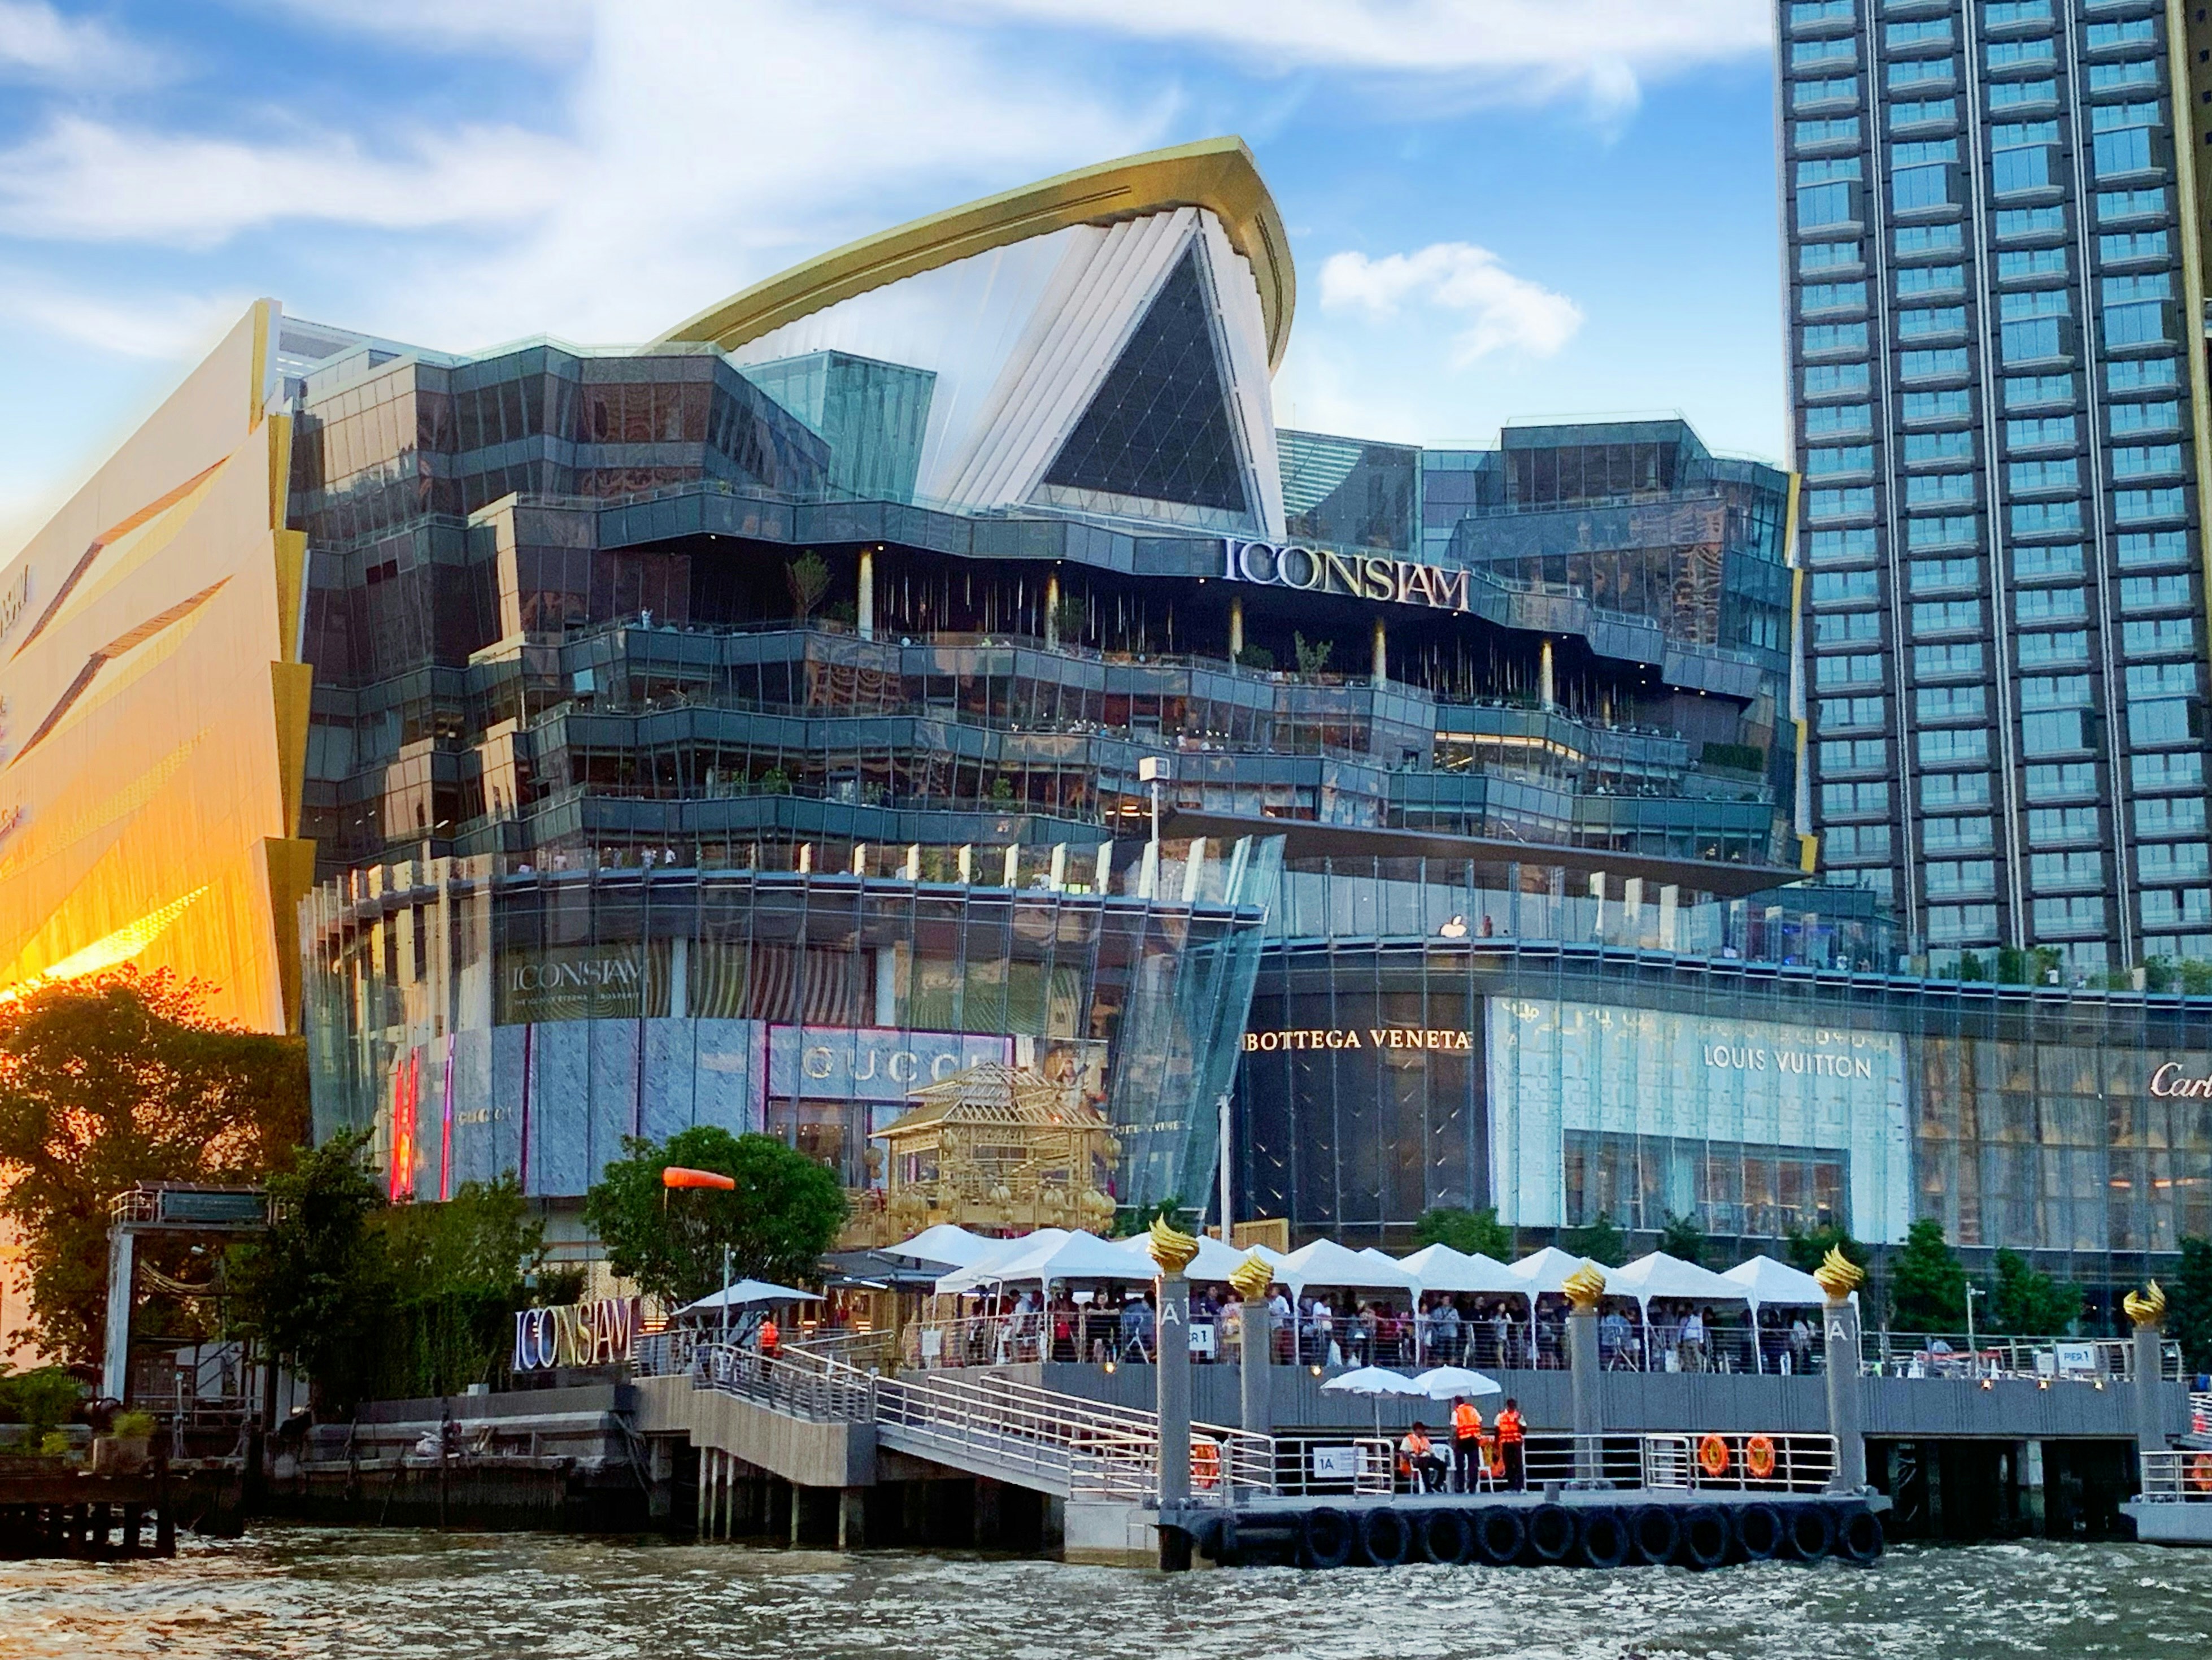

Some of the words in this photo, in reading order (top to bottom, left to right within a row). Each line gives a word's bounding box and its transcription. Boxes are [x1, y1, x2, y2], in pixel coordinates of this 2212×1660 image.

[1222, 537, 1473, 612] ICONSIAM
[512, 959, 650, 991] ICONSIAM
[1242, 1029, 1361, 1051] BOTTEGA
[1369, 1029, 1472, 1049] VENETA
[1704, 1044, 1765, 1071] LOUIS
[1774, 1050, 1871, 1079] VUITTON
[513, 1298, 633, 1371] ICONSIAM
[1320, 1458, 1335, 1470] 1A
